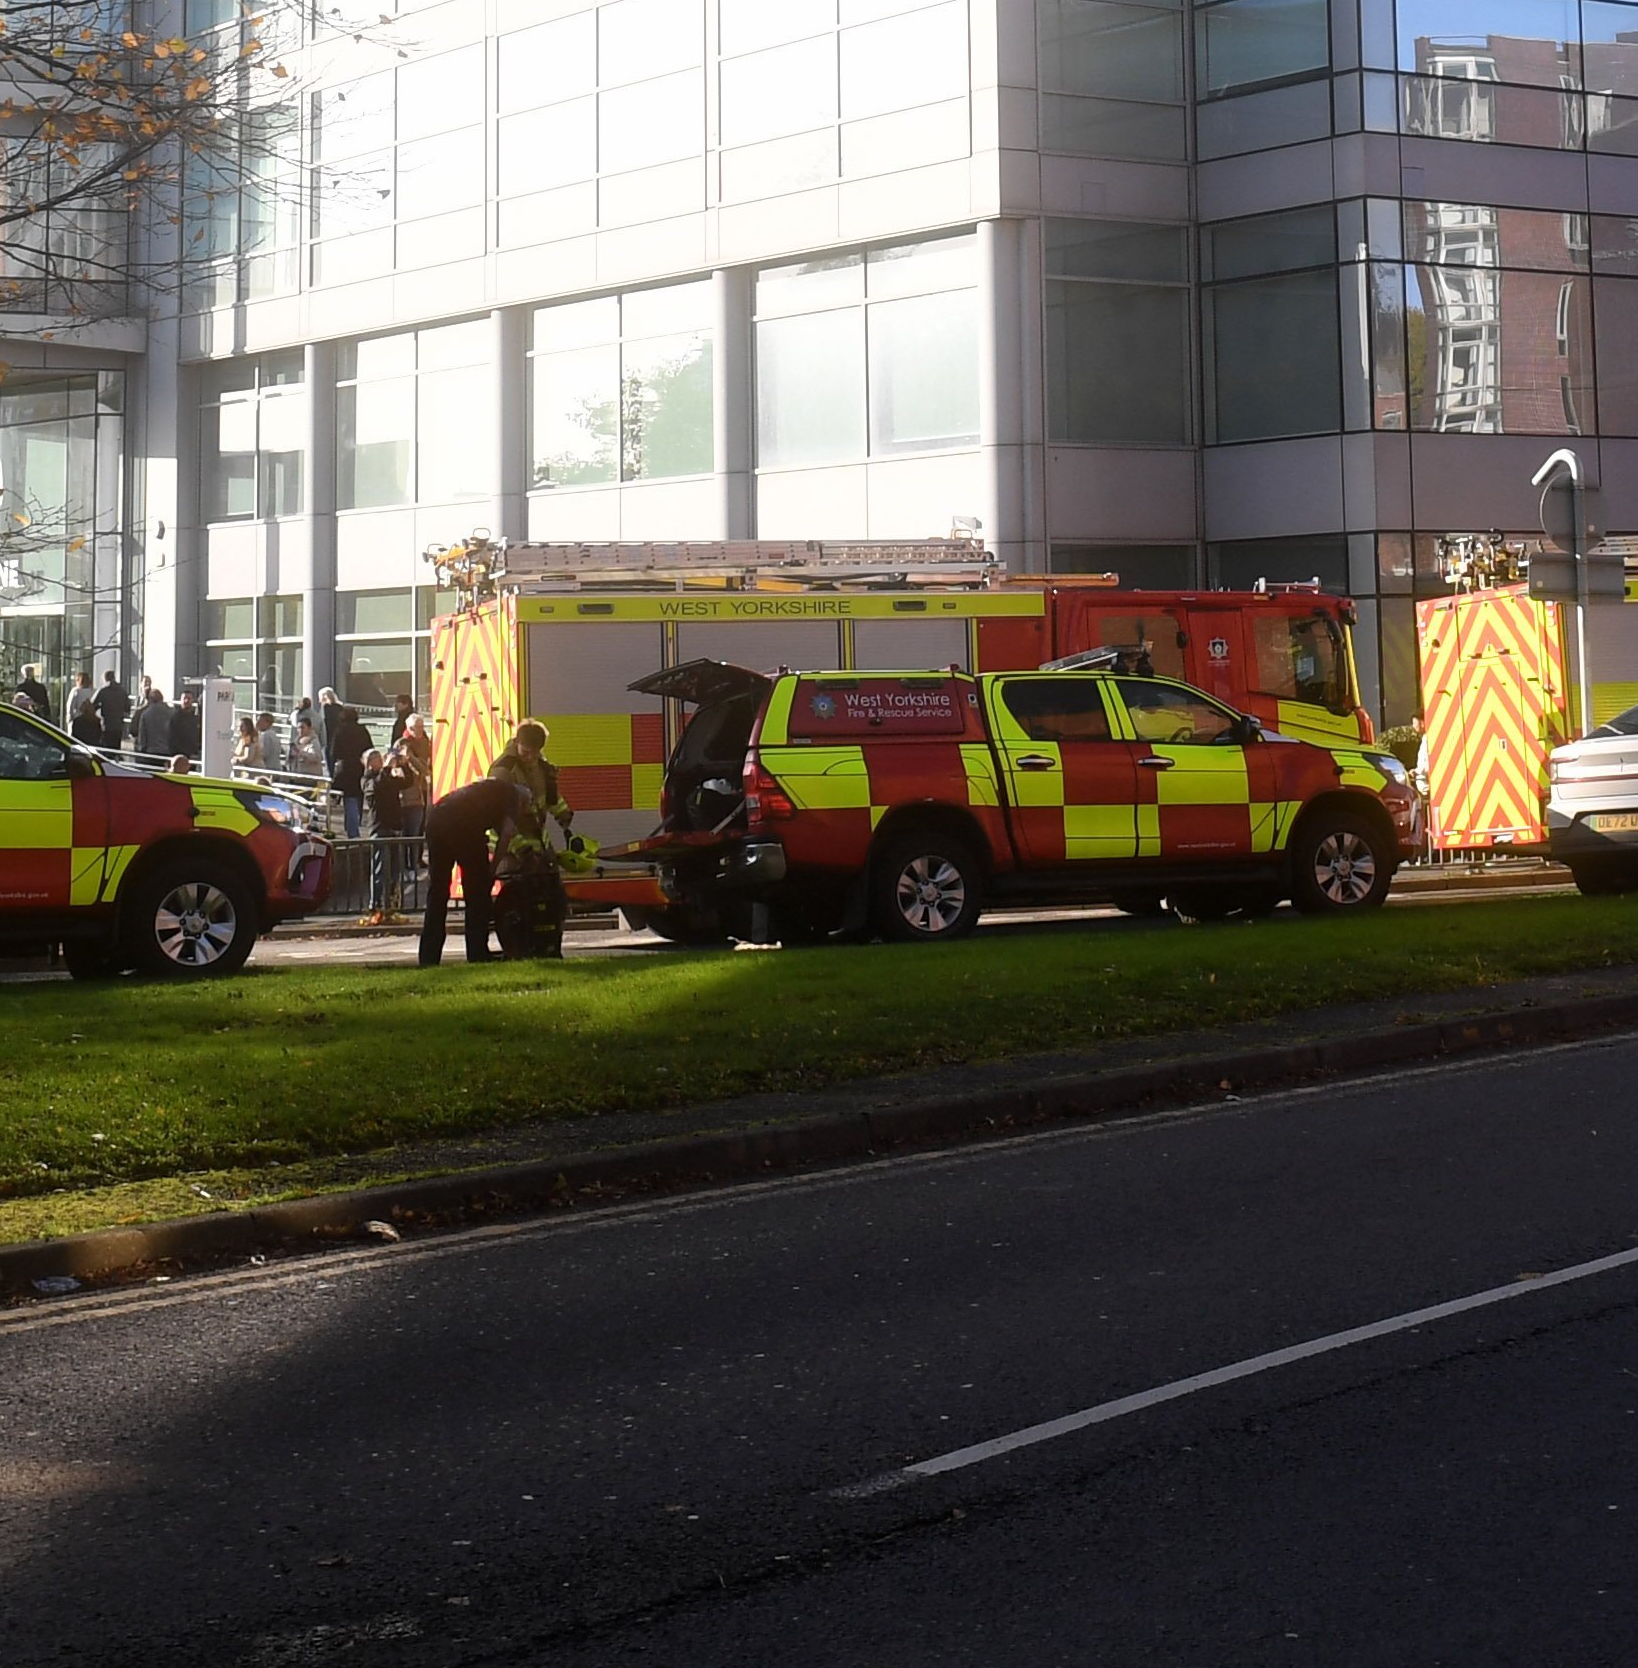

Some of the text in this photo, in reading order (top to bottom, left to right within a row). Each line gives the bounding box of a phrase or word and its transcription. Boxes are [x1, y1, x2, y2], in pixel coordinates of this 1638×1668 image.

[660, 601, 852, 615] WEST YORKSHIRE
[844, 692, 950, 707] West Yorkshire
[848, 707, 952, 717] Fire & Rescue Service
